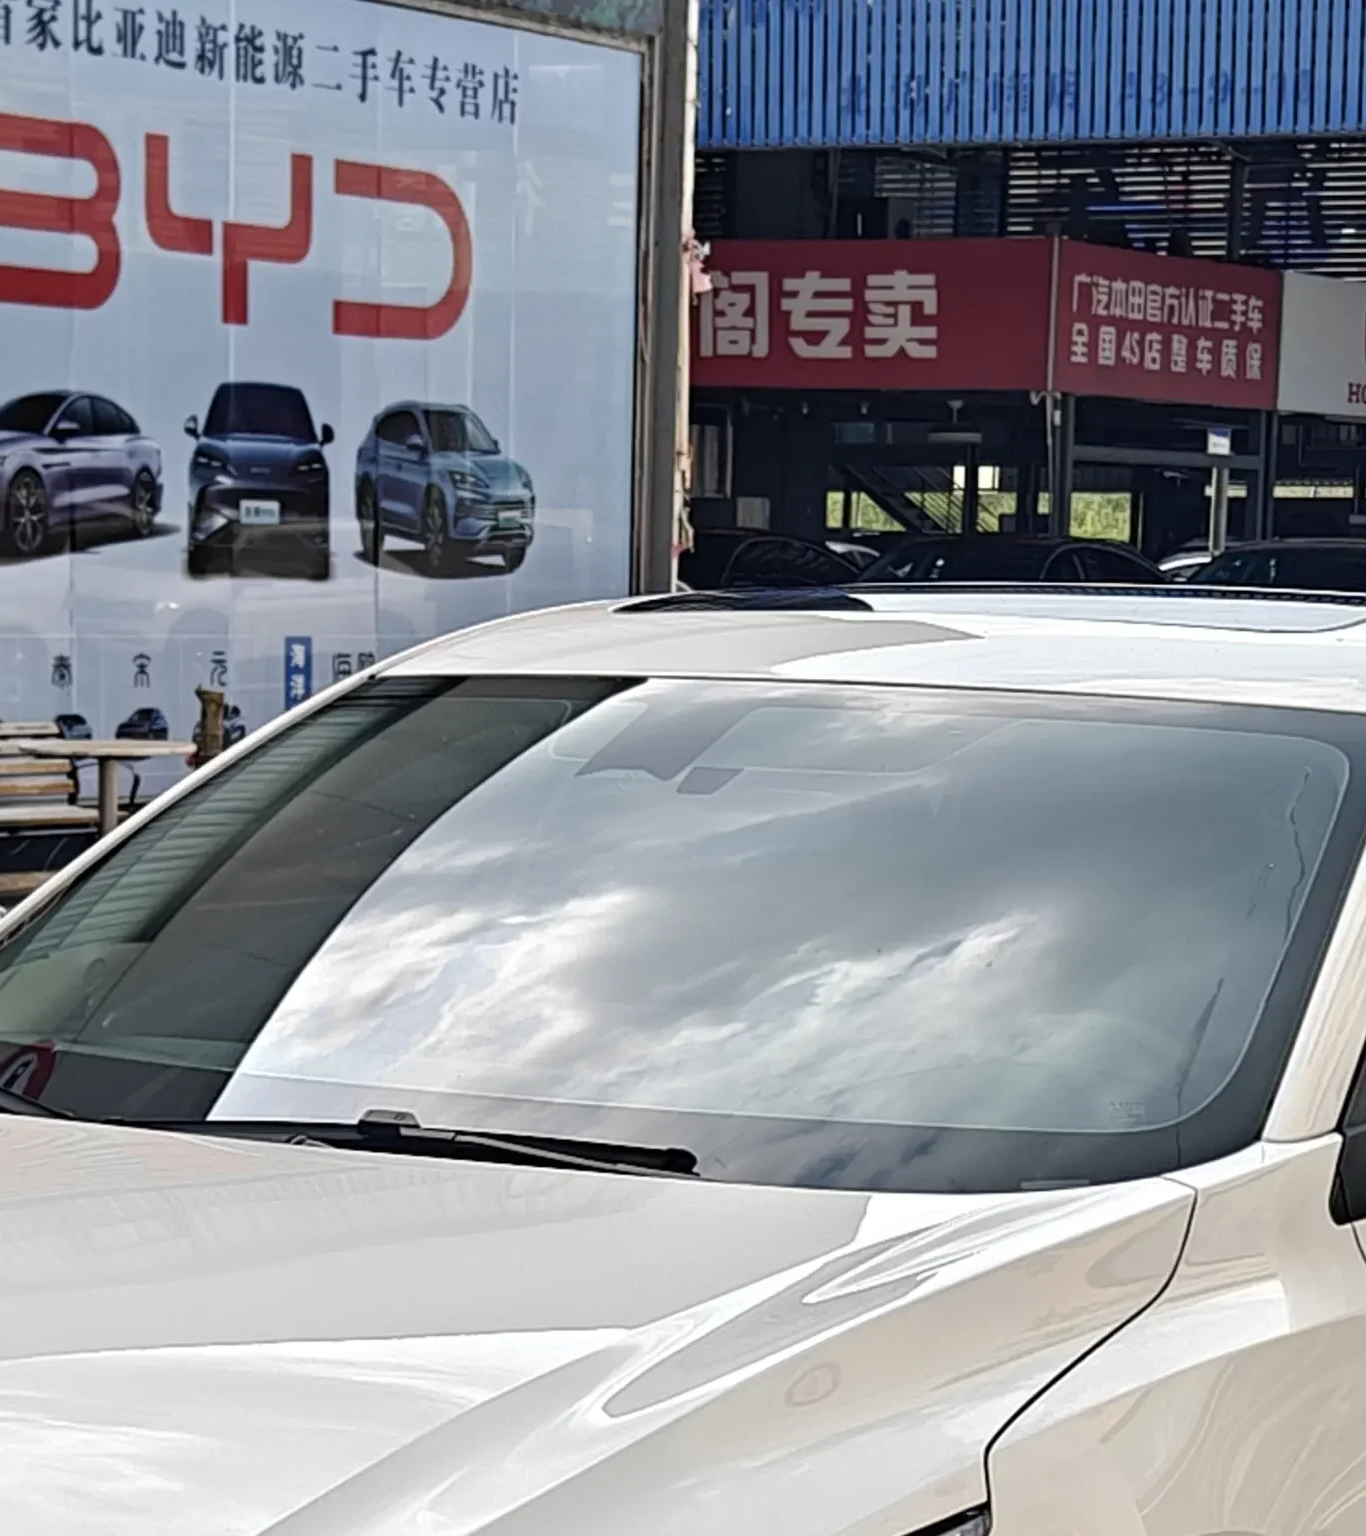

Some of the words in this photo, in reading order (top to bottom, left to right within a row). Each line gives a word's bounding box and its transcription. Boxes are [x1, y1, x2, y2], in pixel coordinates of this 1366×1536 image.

[699, 269, 938, 360] 阁专卖
[1072, 272, 1264, 335] 广汽本田官方认证二手车
